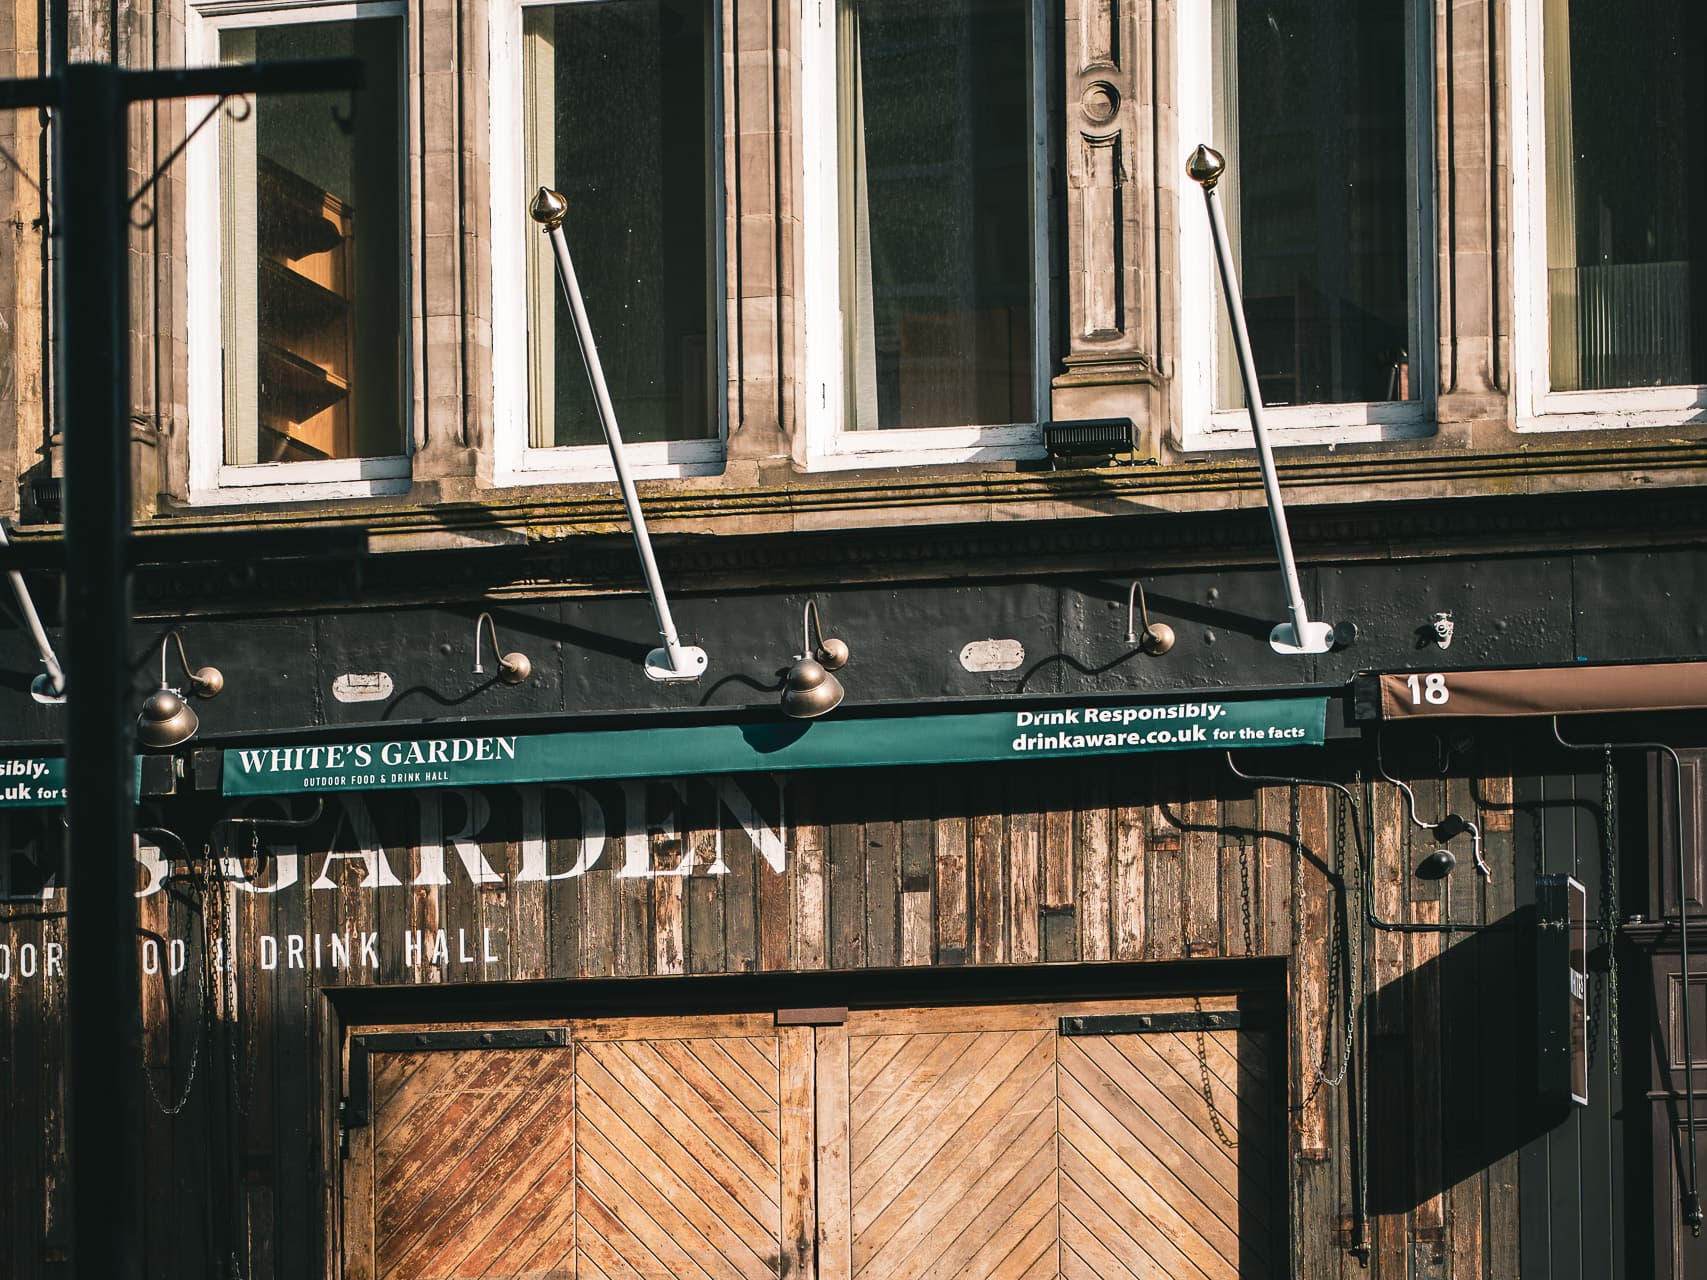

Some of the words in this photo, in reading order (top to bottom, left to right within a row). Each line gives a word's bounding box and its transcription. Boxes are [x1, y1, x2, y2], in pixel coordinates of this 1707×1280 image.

[1407, 673, 1450, 705] 18
[1016, 708, 1080, 727] Drink
[1084, 703, 1227, 725] Responsibly.
[1012, 725, 1207, 751] drinkaware.co.uk
[1213, 728, 1236, 741] for
[1239, 727, 1265, 740] the
[1268, 726, 1305, 739] facts
[238, 743, 372, 774] WHITE'S
[381, 736, 518, 766] GARDEN
[37, 787, 59, 799] for
[303, 774, 346, 787] OUTDOOR
[351, 774, 375, 786] FOOD
[380, 773, 387, 784] &
[391, 771, 421, 783] DRINK
[425, 770, 449, 782] HALL
[214, 773, 794, 893] GARDEN
[260, 931, 380, 970] DRINK
[404, 927, 499, 968] HALL
